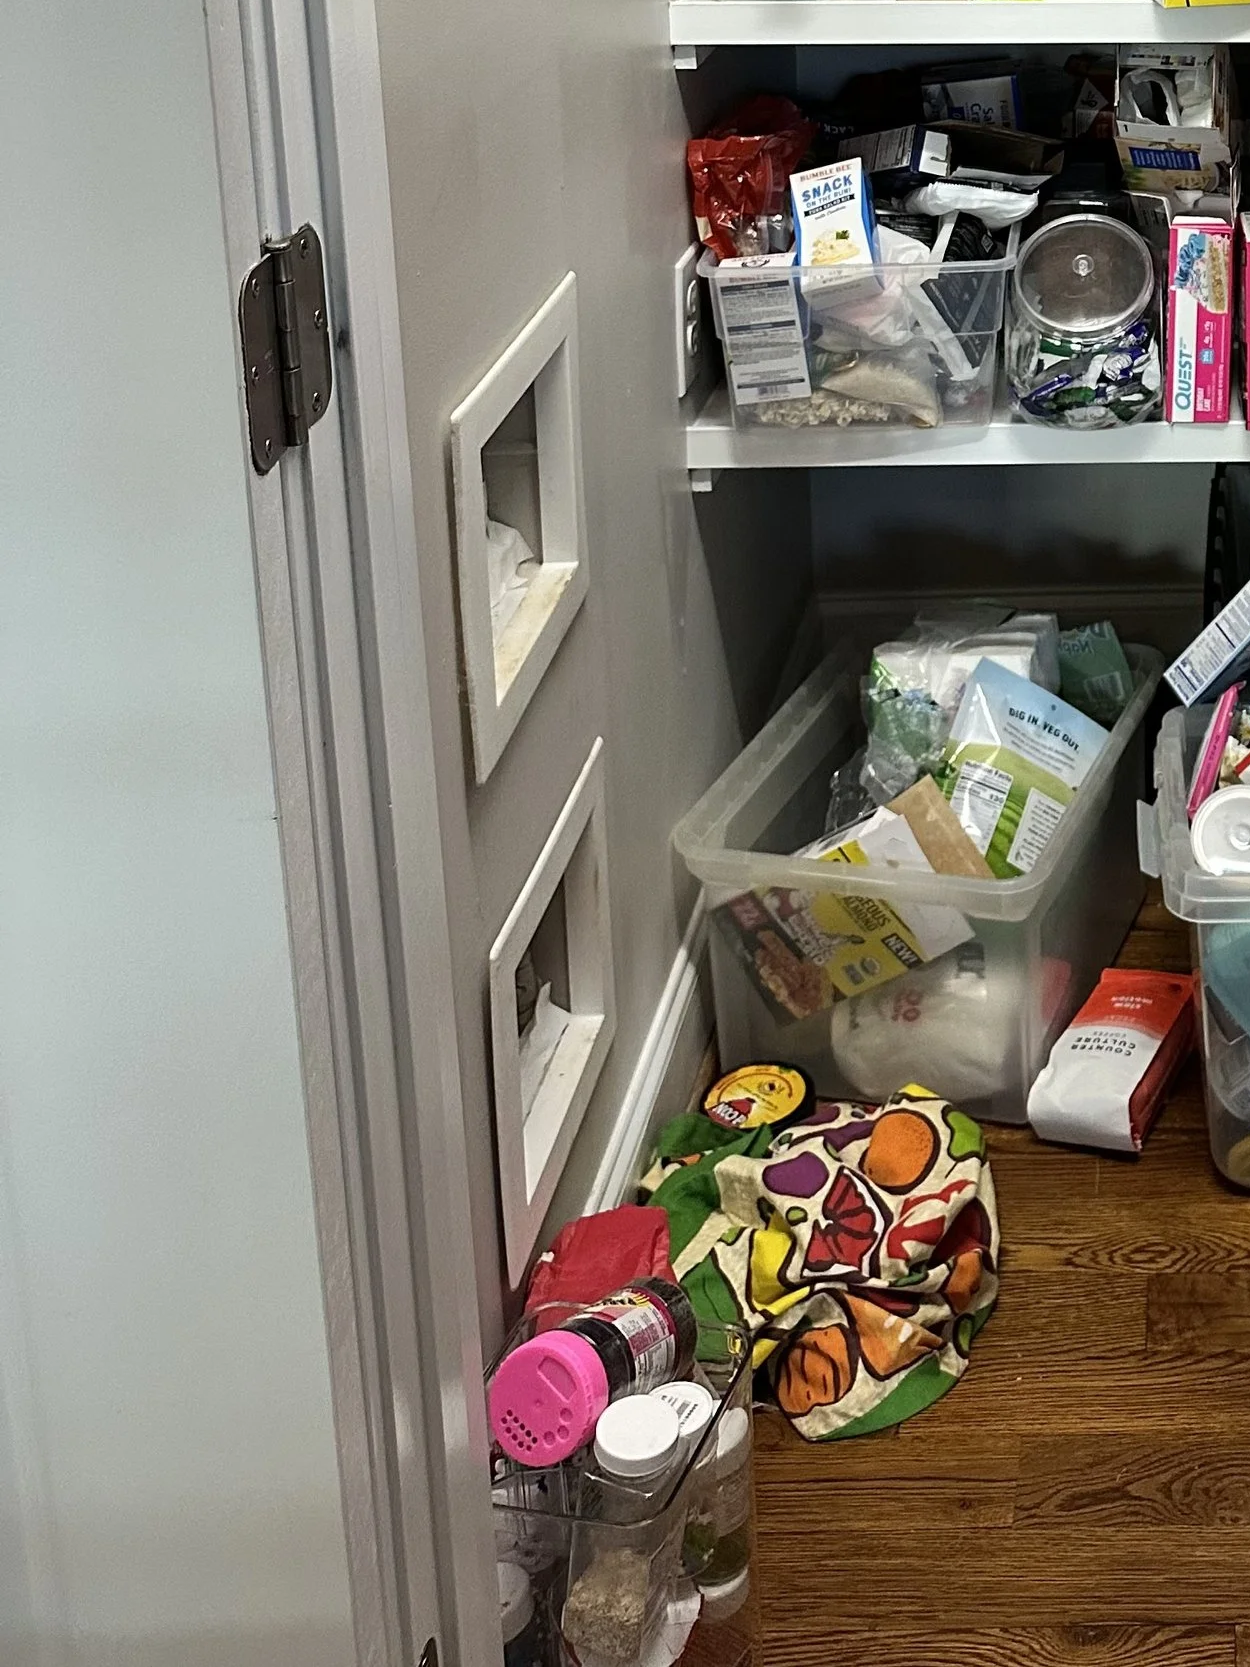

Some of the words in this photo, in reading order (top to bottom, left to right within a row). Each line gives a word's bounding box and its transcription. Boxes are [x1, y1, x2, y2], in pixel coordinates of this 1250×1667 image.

[801, 173, 853, 203] SNACK
[1174, 347, 1193, 411] QUEST
[1042, 722, 1061, 737] VEG
